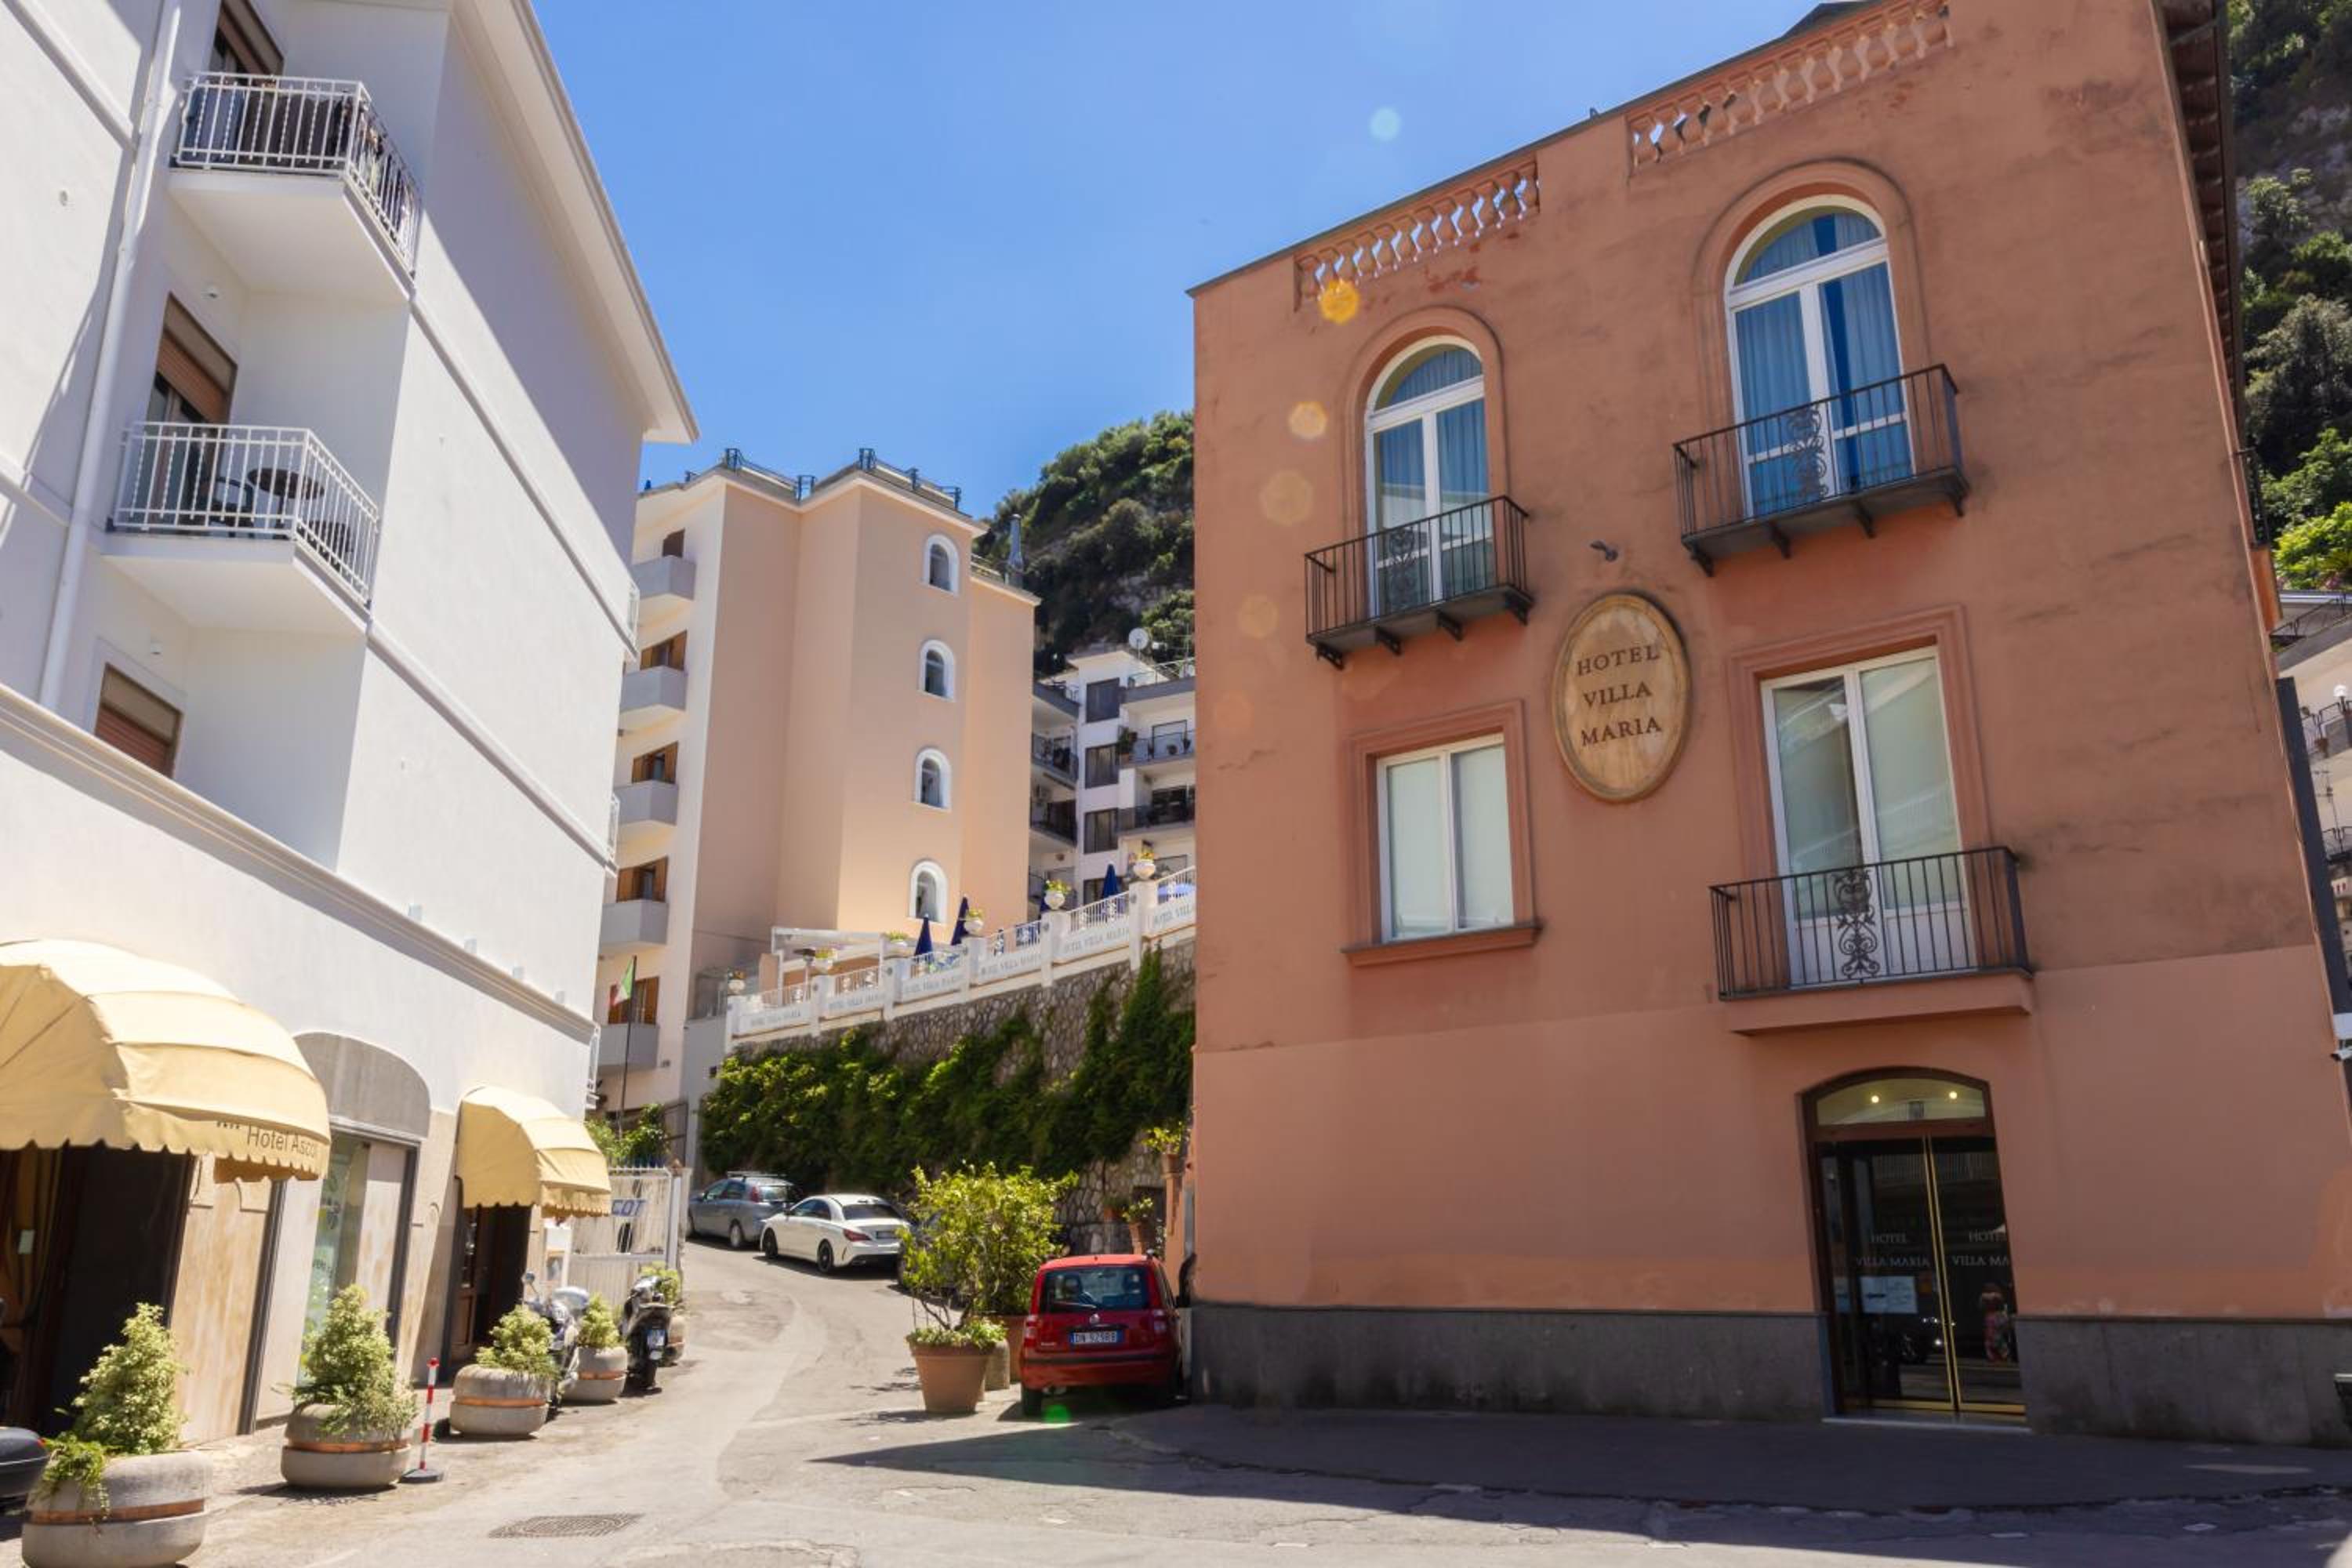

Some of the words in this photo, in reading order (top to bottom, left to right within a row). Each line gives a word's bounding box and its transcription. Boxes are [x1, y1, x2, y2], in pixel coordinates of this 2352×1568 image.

[1577, 644, 1661, 676] HOTEL
[1584, 681, 1653, 707] VILLA
[1581, 717, 1662, 746] MARIA
[247, 1125, 287, 1152] Hotel
[291, 1134, 316, 1159] Asco
[1951, 1254, 1987, 1267] VILLA
